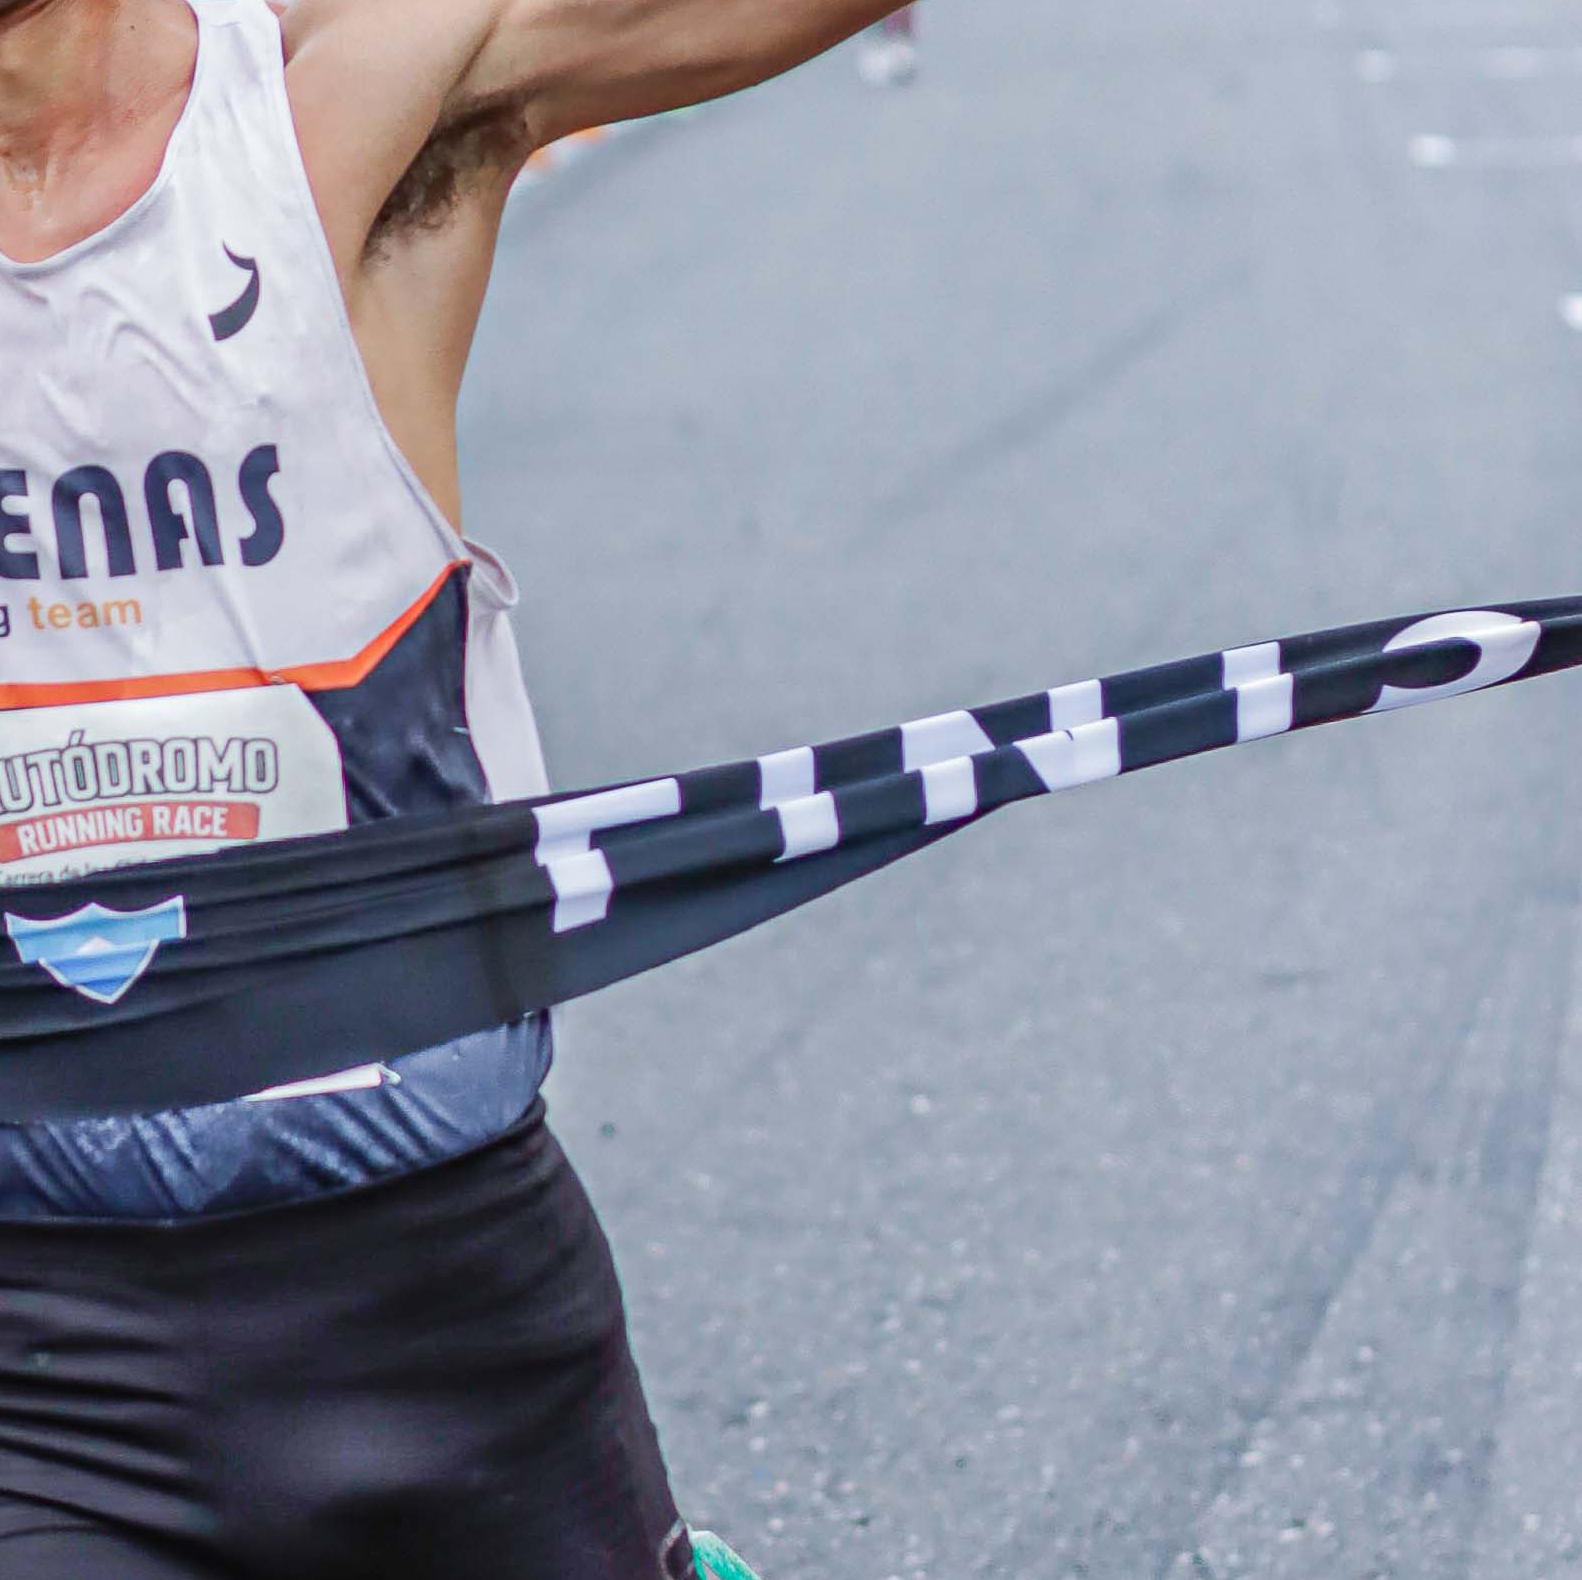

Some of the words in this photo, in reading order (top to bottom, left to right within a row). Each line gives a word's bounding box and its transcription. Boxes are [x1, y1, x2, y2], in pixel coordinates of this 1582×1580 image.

[27, 596, 143, 629] team
[15, 807, 145, 857] RUNNING
[152, 804, 229, 839] RACE
